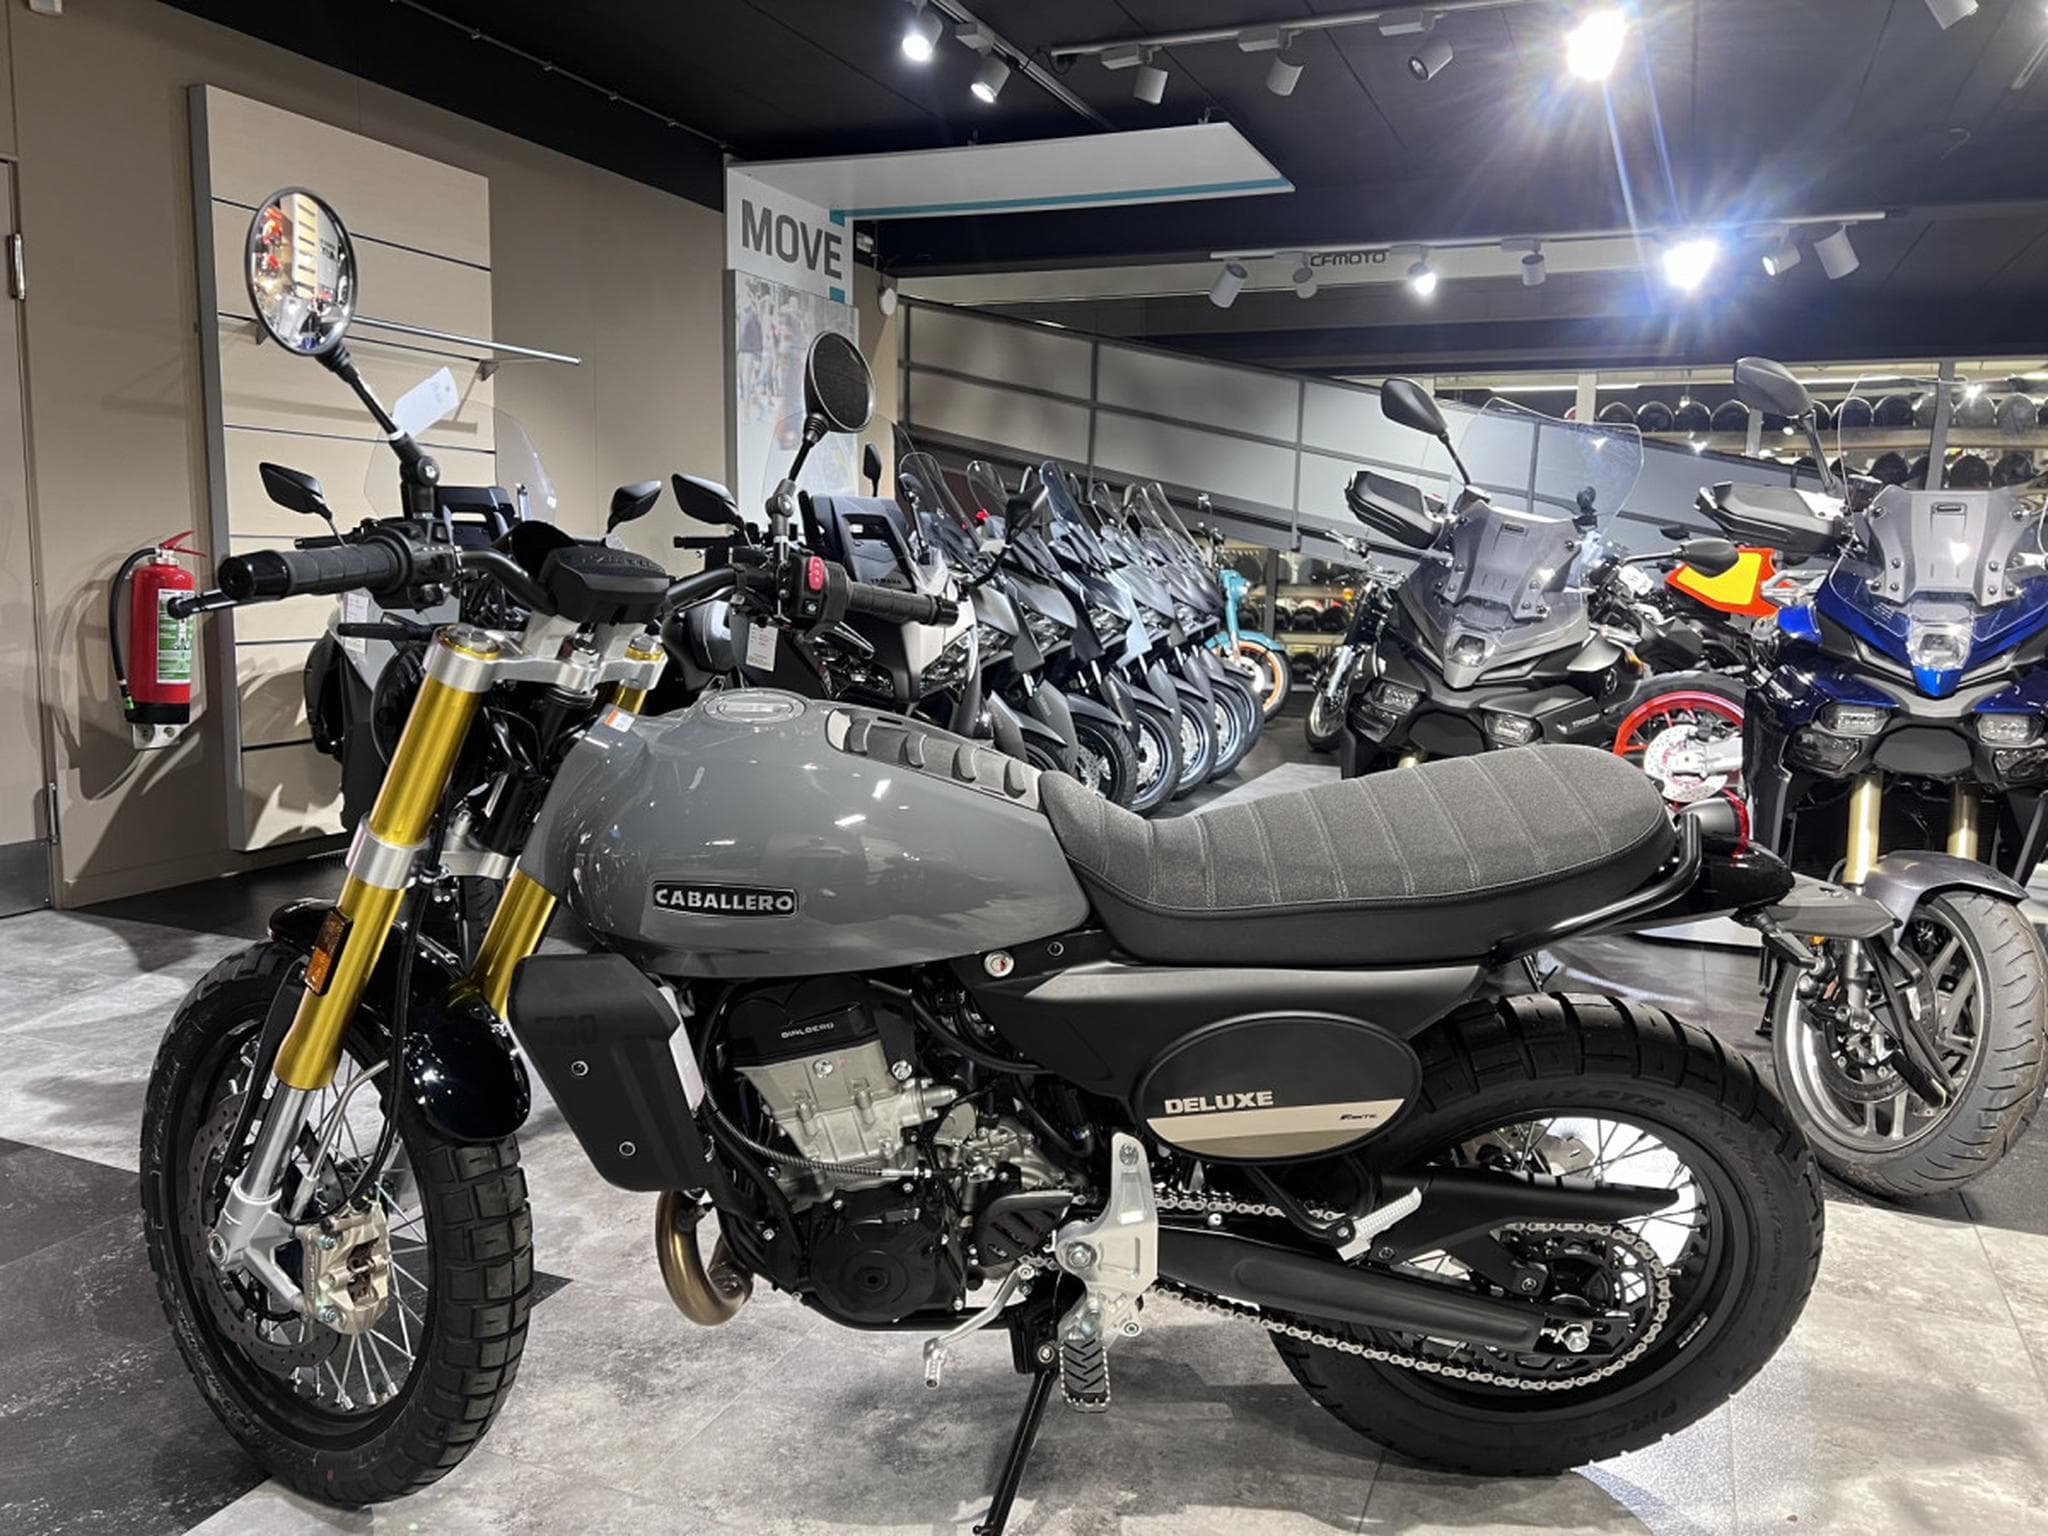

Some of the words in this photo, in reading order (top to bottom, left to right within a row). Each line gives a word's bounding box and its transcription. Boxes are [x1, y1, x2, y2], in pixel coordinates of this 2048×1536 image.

[742, 199, 842, 280] MOVE
[655, 888, 794, 911] CABALLERO
[1165, 1091, 1274, 1114] DELUXE
